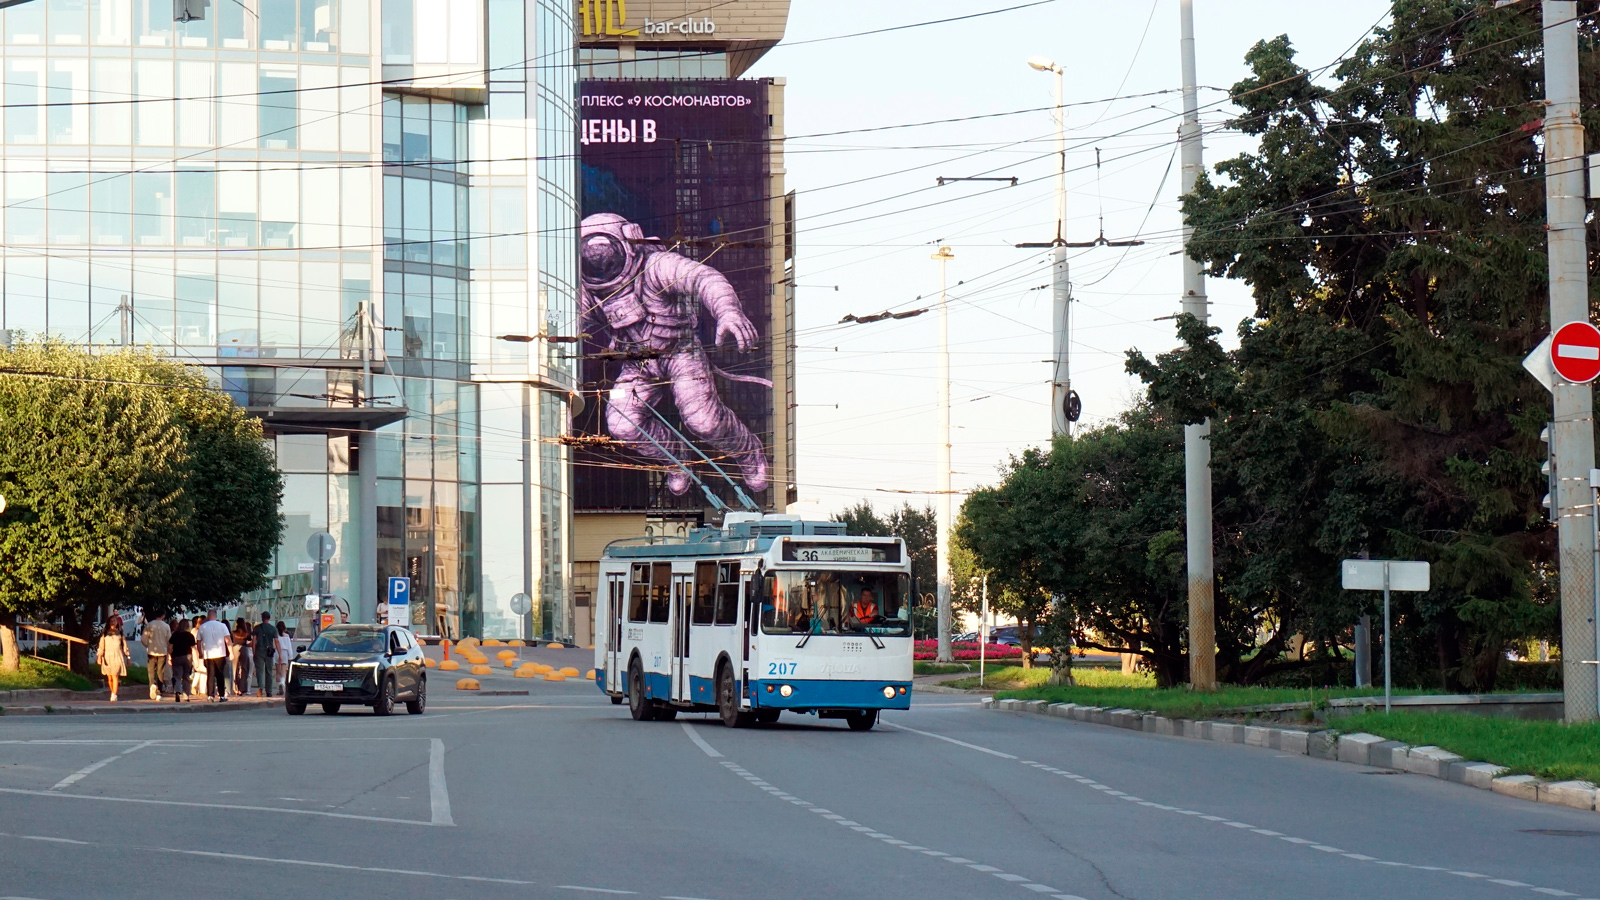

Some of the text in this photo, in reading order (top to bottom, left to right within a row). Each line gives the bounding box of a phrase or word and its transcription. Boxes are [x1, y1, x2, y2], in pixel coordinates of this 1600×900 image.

[644, 17, 716, 34] bar-club
[581, 95, 752, 107] ПЛЕКС «9 КОСМОНАВТОВ»
[643, 119, 657, 143] В
[802, 550, 818, 561] 36
[394, 580, 406, 599] P
[768, 662, 797, 675] 207
